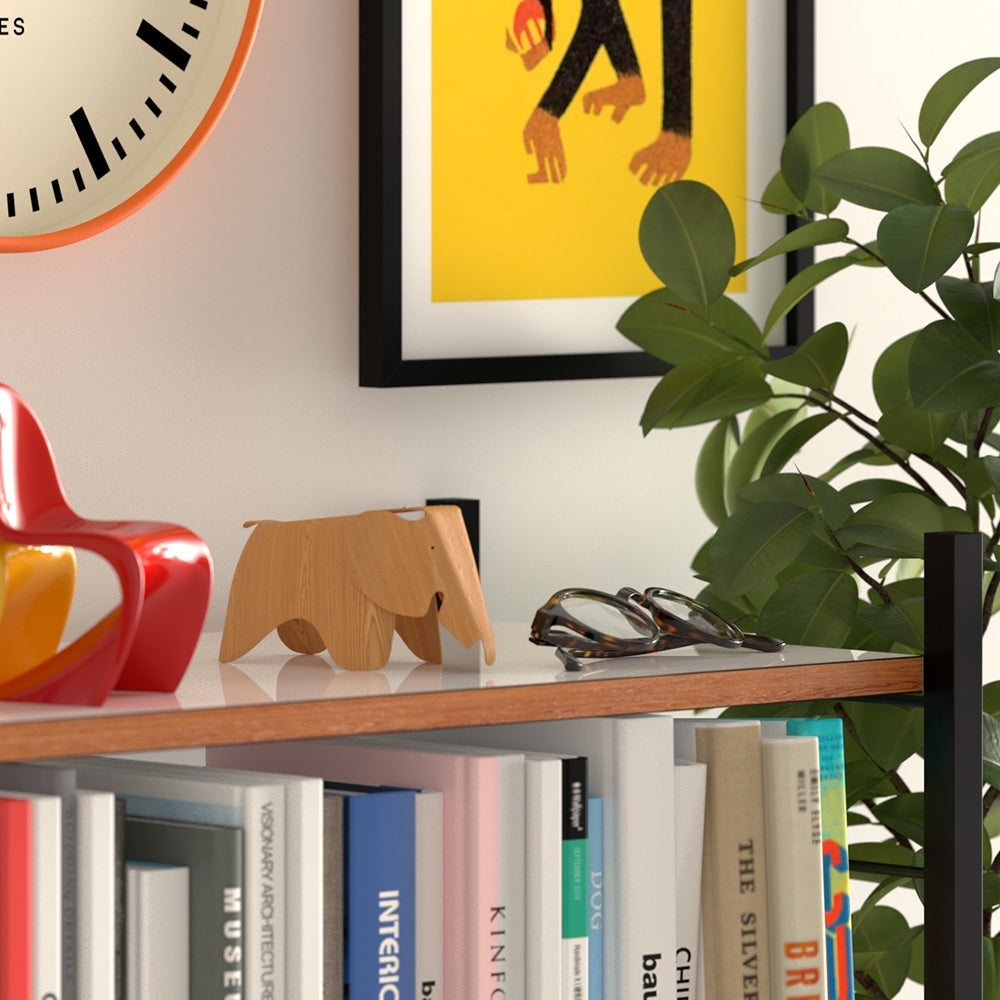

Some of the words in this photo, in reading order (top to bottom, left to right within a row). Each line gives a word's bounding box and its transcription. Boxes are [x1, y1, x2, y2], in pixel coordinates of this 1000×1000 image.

[261, 801, 274, 881] VISIONARY
[738, 838, 755, 895] THE
[676, 947, 692, 1000] CHI
